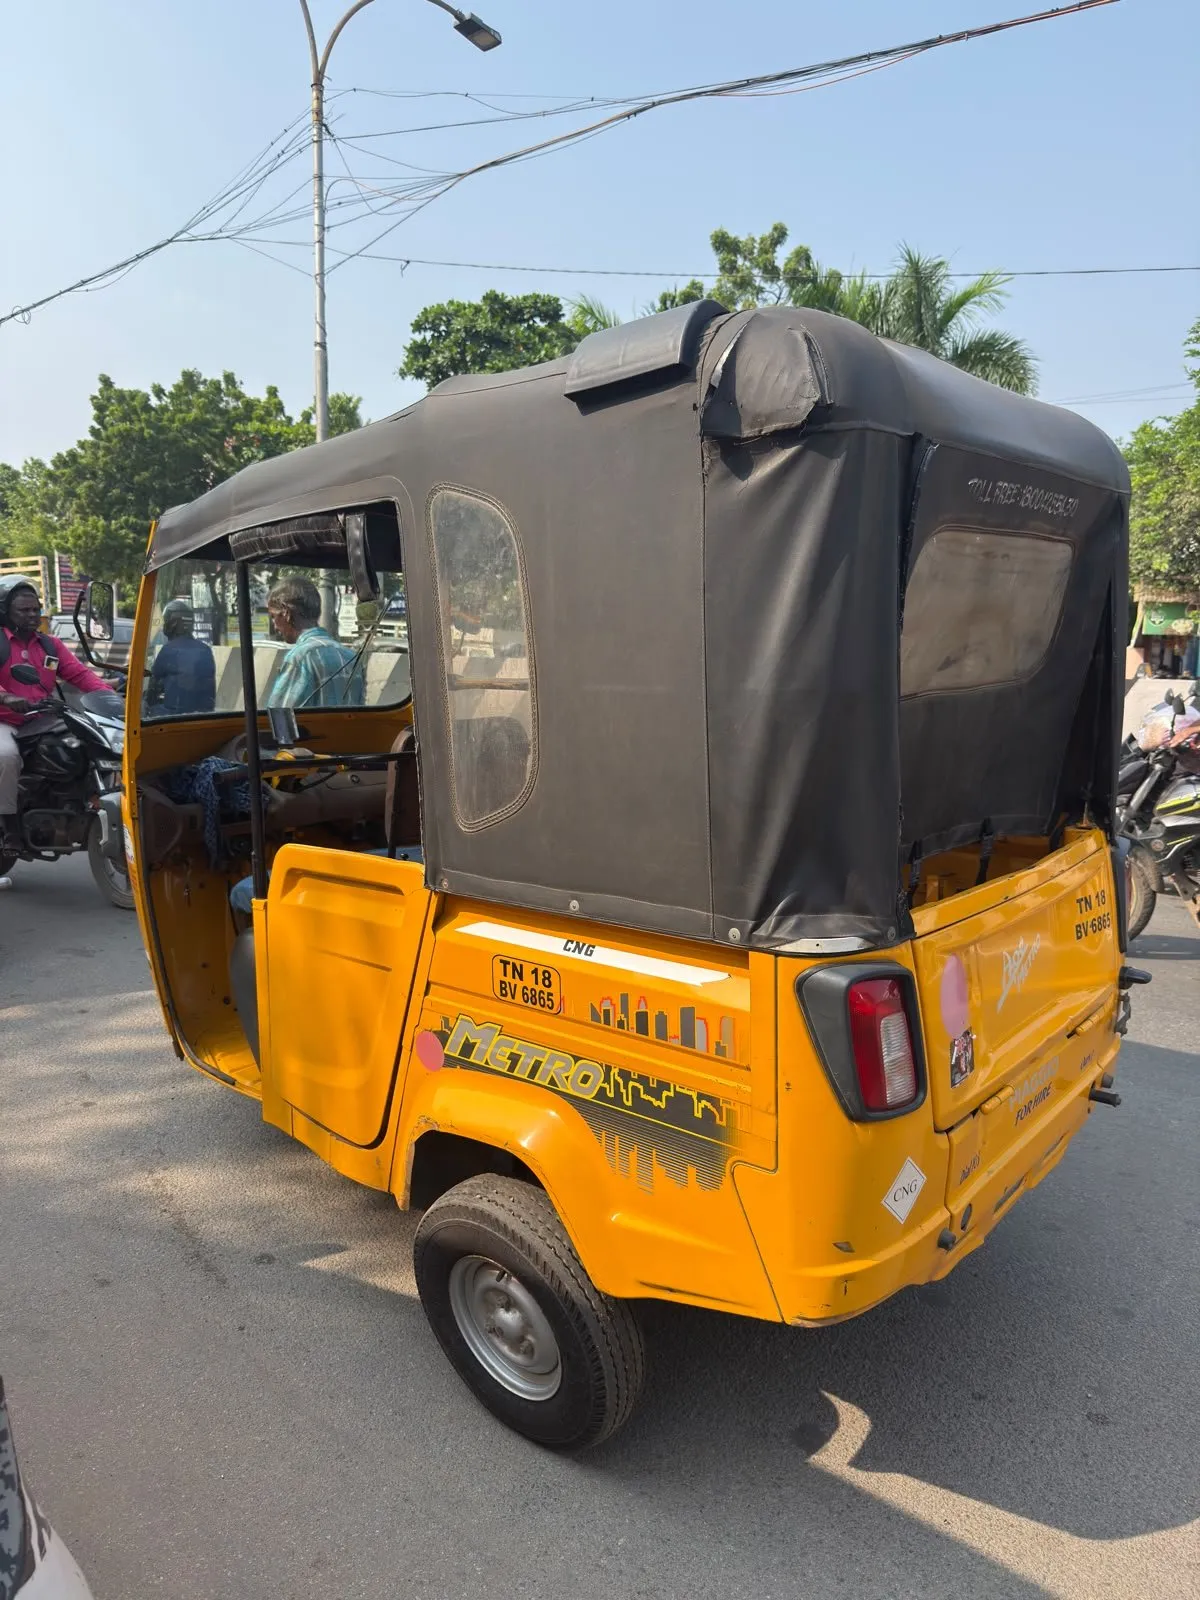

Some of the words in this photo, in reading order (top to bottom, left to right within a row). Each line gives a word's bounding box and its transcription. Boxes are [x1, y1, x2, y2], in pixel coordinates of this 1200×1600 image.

[1075, 894, 1093, 914] TN
[1095, 889, 1106, 907] 18
[562, 939, 597, 957] CNG
[499, 958, 524, 981] TN
[531, 967, 553, 988] 18
[499, 979, 517, 1000] BV
[521, 985, 555, 1010] 6865
[1014, 1099, 1033, 1127] FOR
[1032, 1080, 1053, 1110] HIRE
[893, 1178, 918, 1202] CNG
